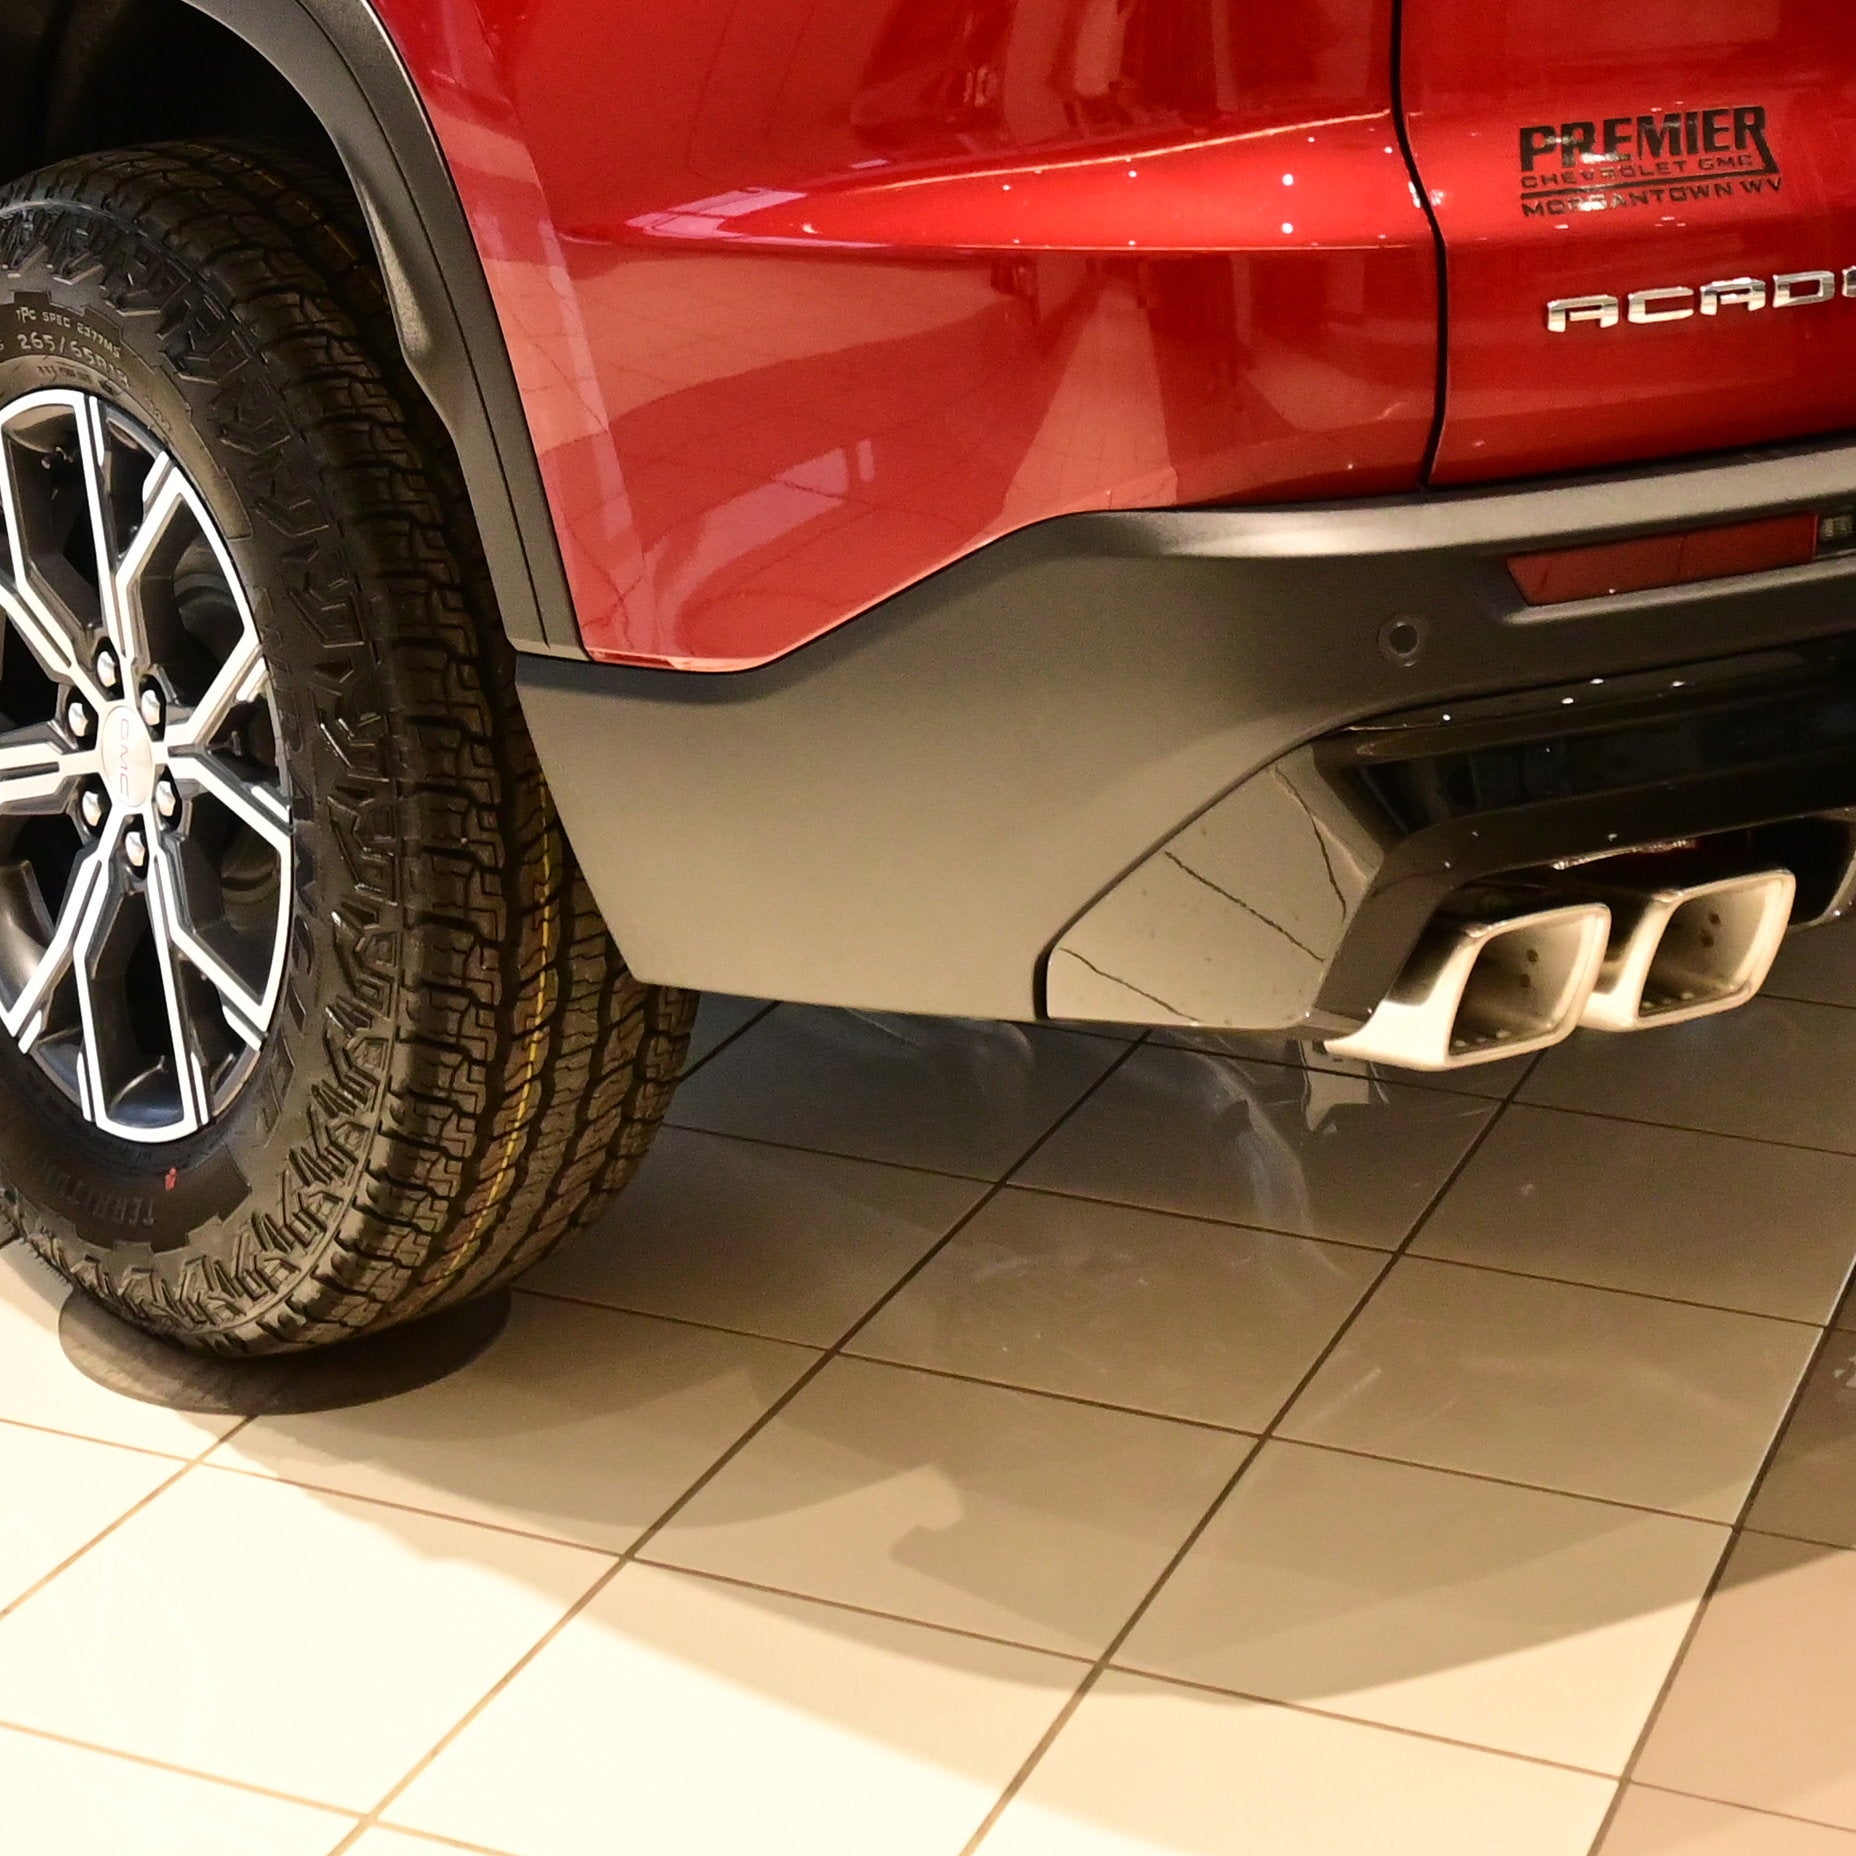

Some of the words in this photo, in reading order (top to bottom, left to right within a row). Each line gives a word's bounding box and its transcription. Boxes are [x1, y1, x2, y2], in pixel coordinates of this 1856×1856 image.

[1519, 106, 1778, 173] PREMIER
[1520, 158, 1686, 189] CHEVROLET
[1698, 153, 1754, 172] GMC
[1740, 177, 1783, 196] WV
[42, 311, 71, 328] SPEC
[119, 717, 130, 798] GMC
